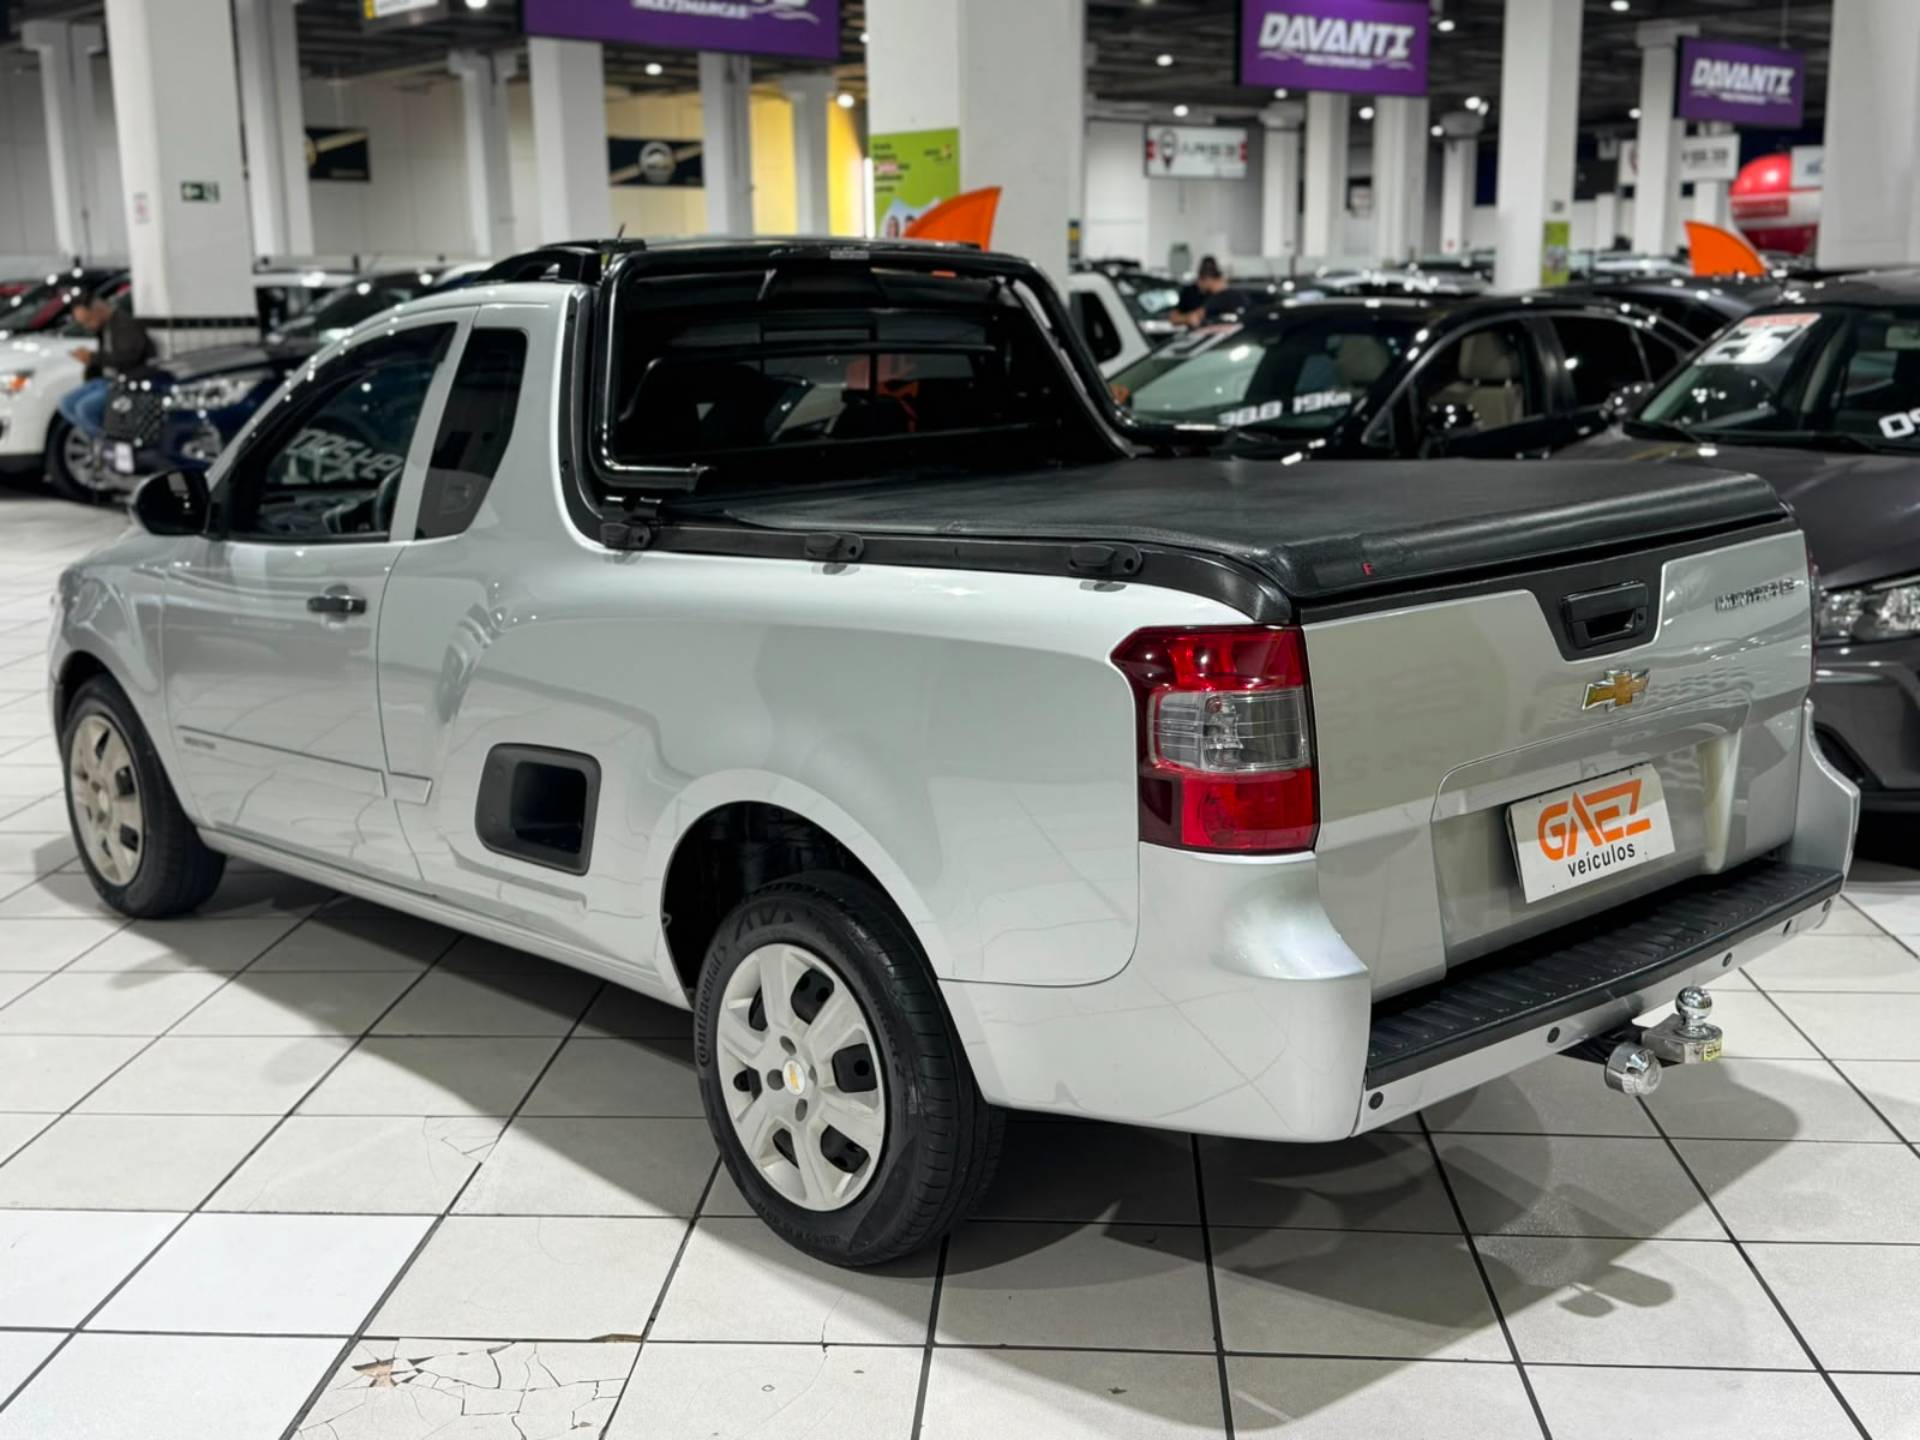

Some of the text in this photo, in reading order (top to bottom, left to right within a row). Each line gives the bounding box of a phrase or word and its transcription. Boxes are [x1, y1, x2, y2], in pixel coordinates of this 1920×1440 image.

[1258, 12, 1415, 59] DAVANTI
[1690, 58, 1795, 96] DAVANTI
[1537, 778, 1652, 861] GAEZ
[1567, 843, 1636, 878] veículos
